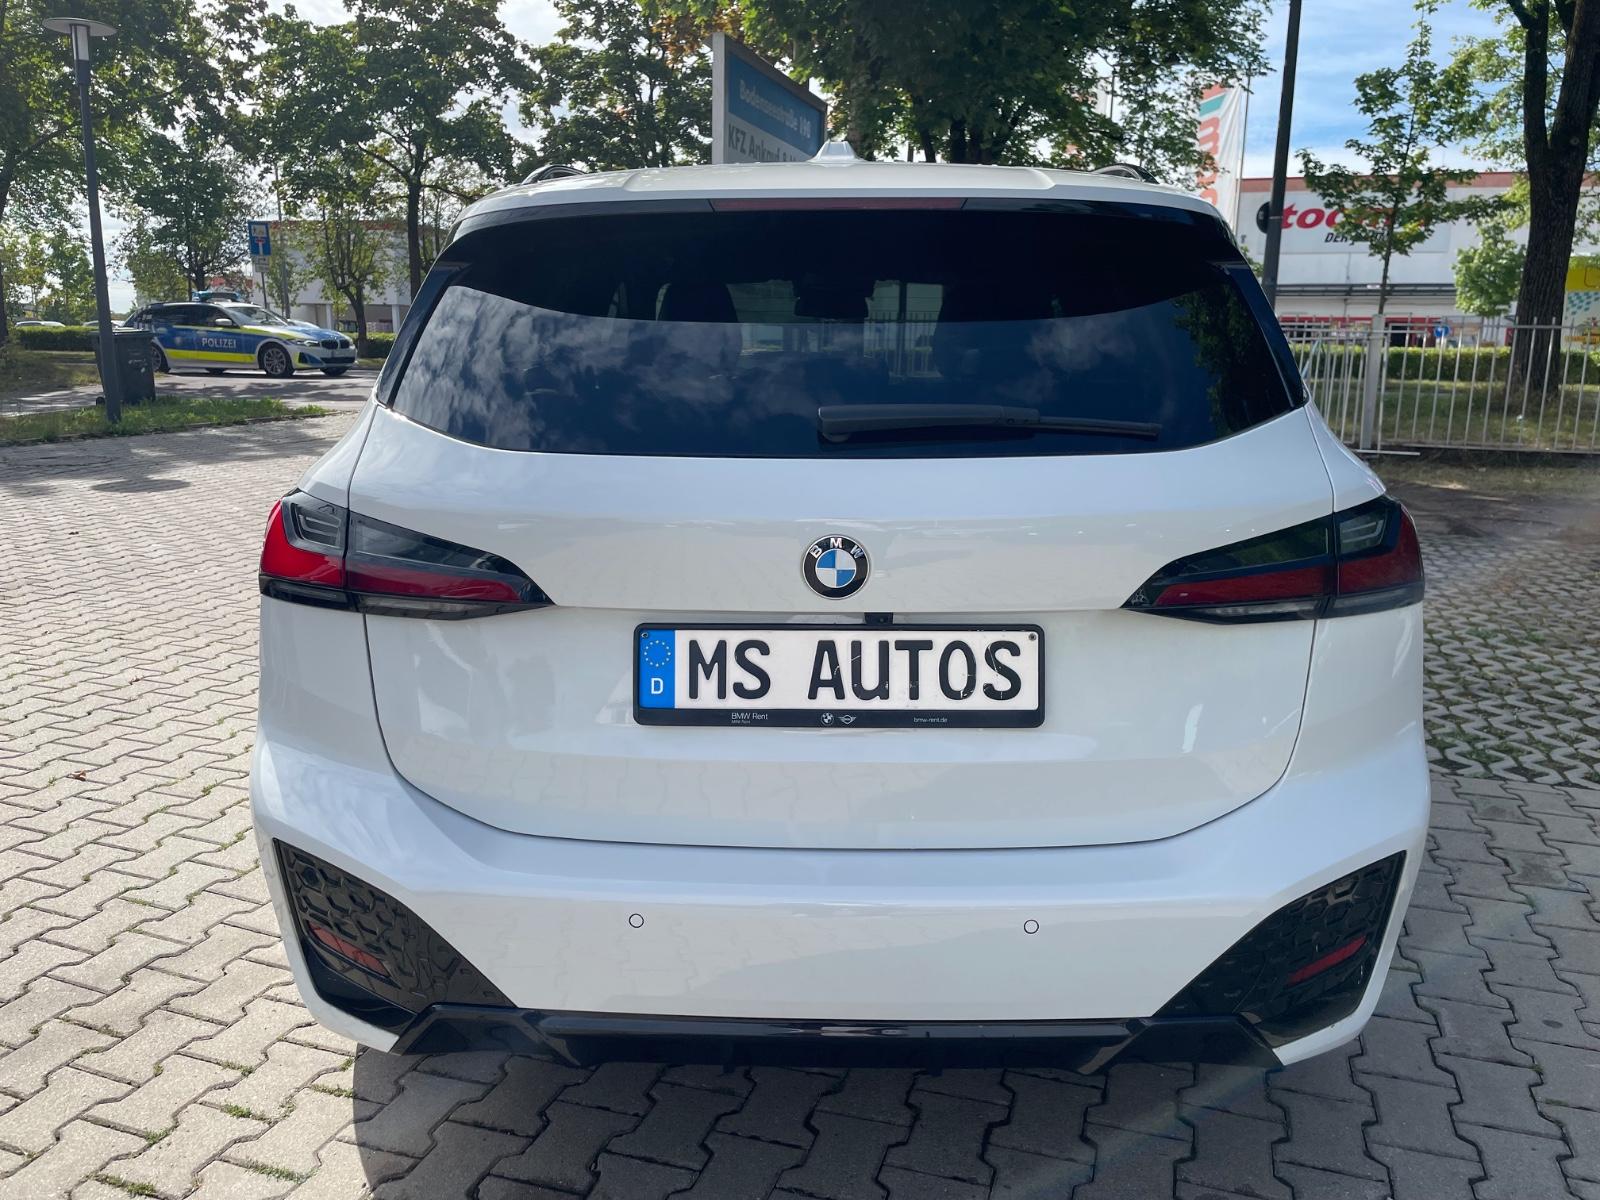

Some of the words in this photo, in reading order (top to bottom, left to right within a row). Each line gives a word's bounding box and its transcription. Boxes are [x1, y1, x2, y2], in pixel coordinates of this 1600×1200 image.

[728, 122, 746, 155] KFZ
[202, 337, 236, 348] POLIZEI
[809, 537, 864, 559] BMW
[688, 639, 771, 700] MS
[807, 639, 1022, 701] AUTOS
[651, 677, 663, 695] D
[731, 712, 751, 720] BMW
[752, 712, 768, 720] Rent
